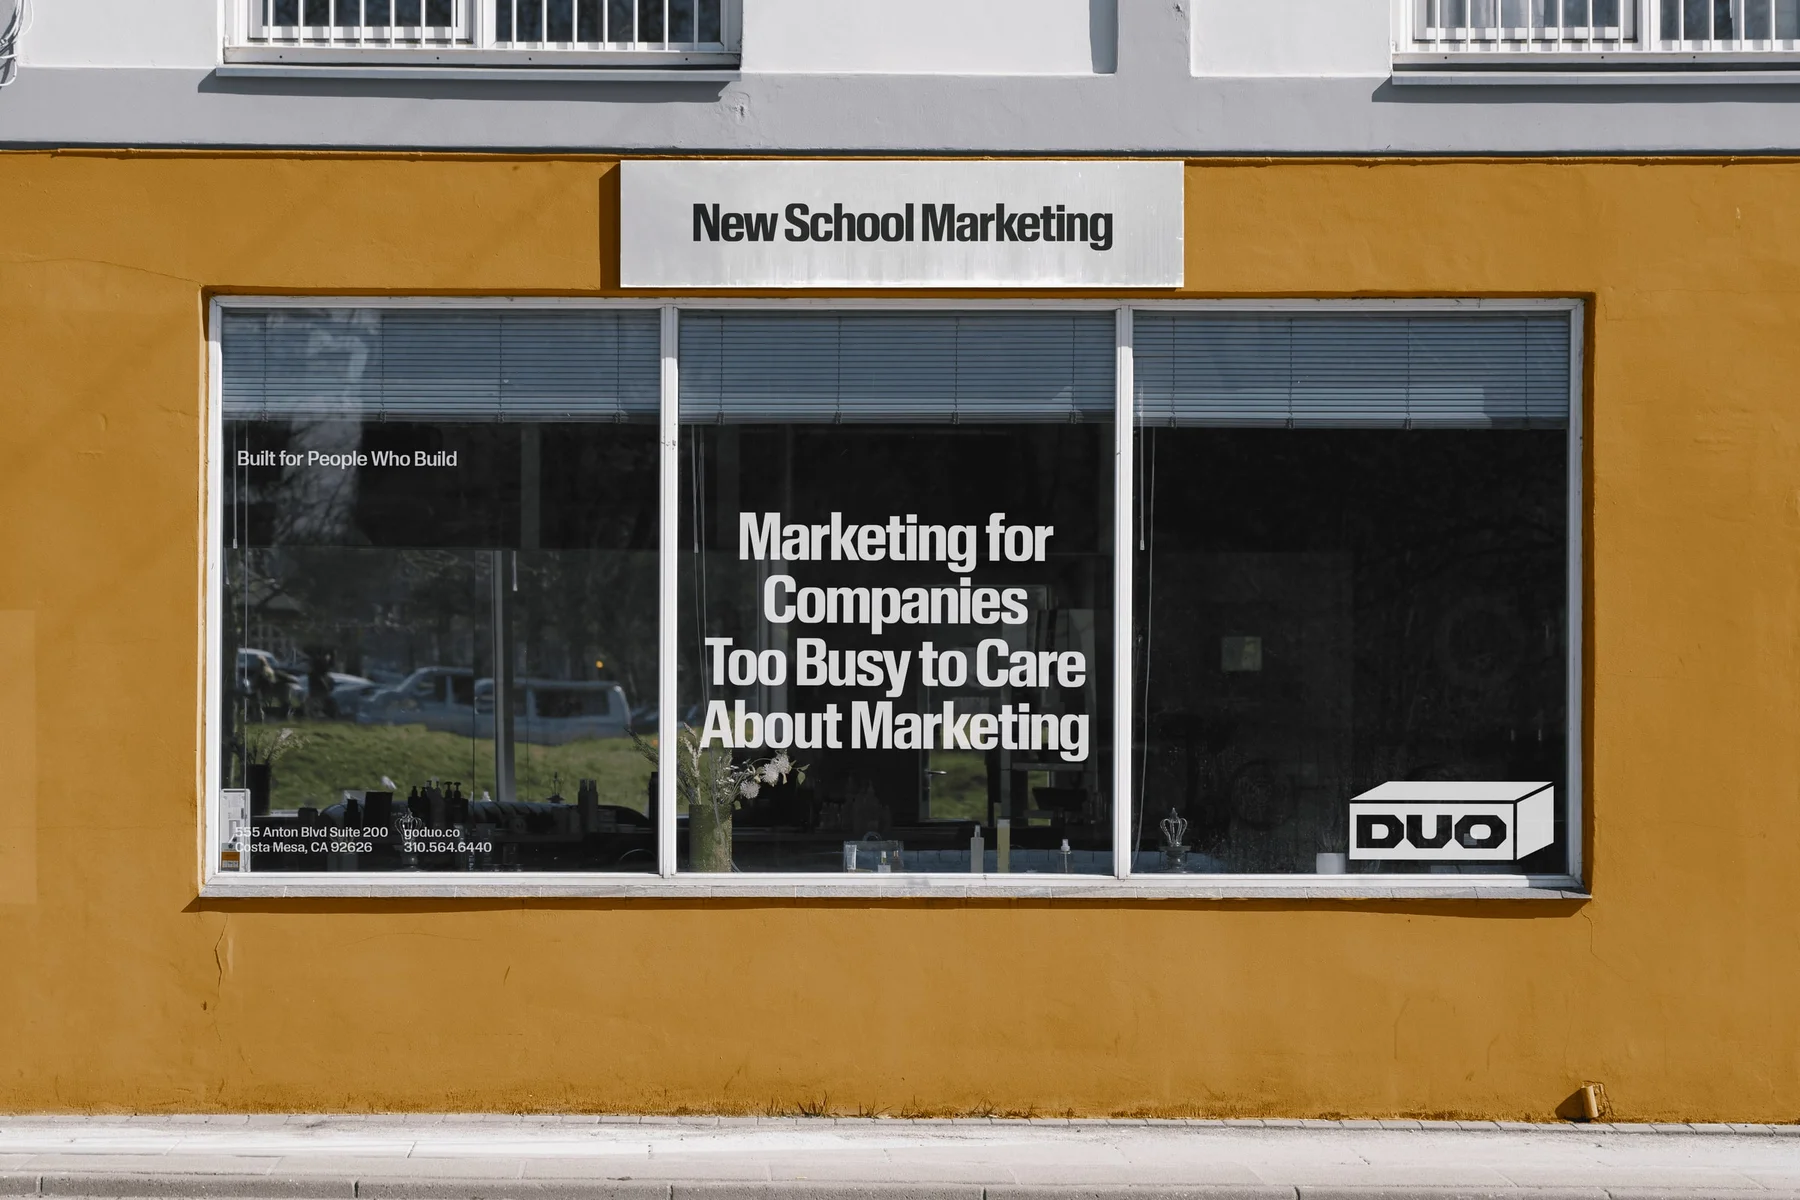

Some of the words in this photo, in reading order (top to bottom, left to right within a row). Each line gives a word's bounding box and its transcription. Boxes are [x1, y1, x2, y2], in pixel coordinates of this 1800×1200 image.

[692, 203, 778, 242] New
[784, 202, 914, 242] School
[921, 203, 1113, 251] Marketing
[237, 450, 276, 467] Built
[278, 450, 305, 467] for
[307, 450, 368, 470] People
[371, 450, 411, 467] Who
[414, 450, 457, 467] Build
[739, 511, 977, 573] Marketing
[985, 512, 1054, 562] for
[763, 574, 1029, 635] Companies
[704, 637, 787, 686] Too
[796, 637, 912, 698] Busy
[918, 641, 968, 687] to
[976, 638, 1086, 688] Care
[700, 699, 843, 749] About
[851, 700, 1090, 762] Marketing
[234, 826, 261, 838] 555
[262, 826, 299, 838] Anton
[301, 826, 327, 838] Blvd
[329, 826, 361, 838] Suite
[362, 826, 389, 838] 200
[235, 841, 270, 853] Costa
[272, 841, 308, 855] Mesa,
[310, 841, 329, 853] CA
[330, 841, 373, 853] 92626
[403, 826, 461, 840] goduo.co
[403, 841, 492, 853] 310.564.6440
[1356, 814, 1507, 849] DUO
